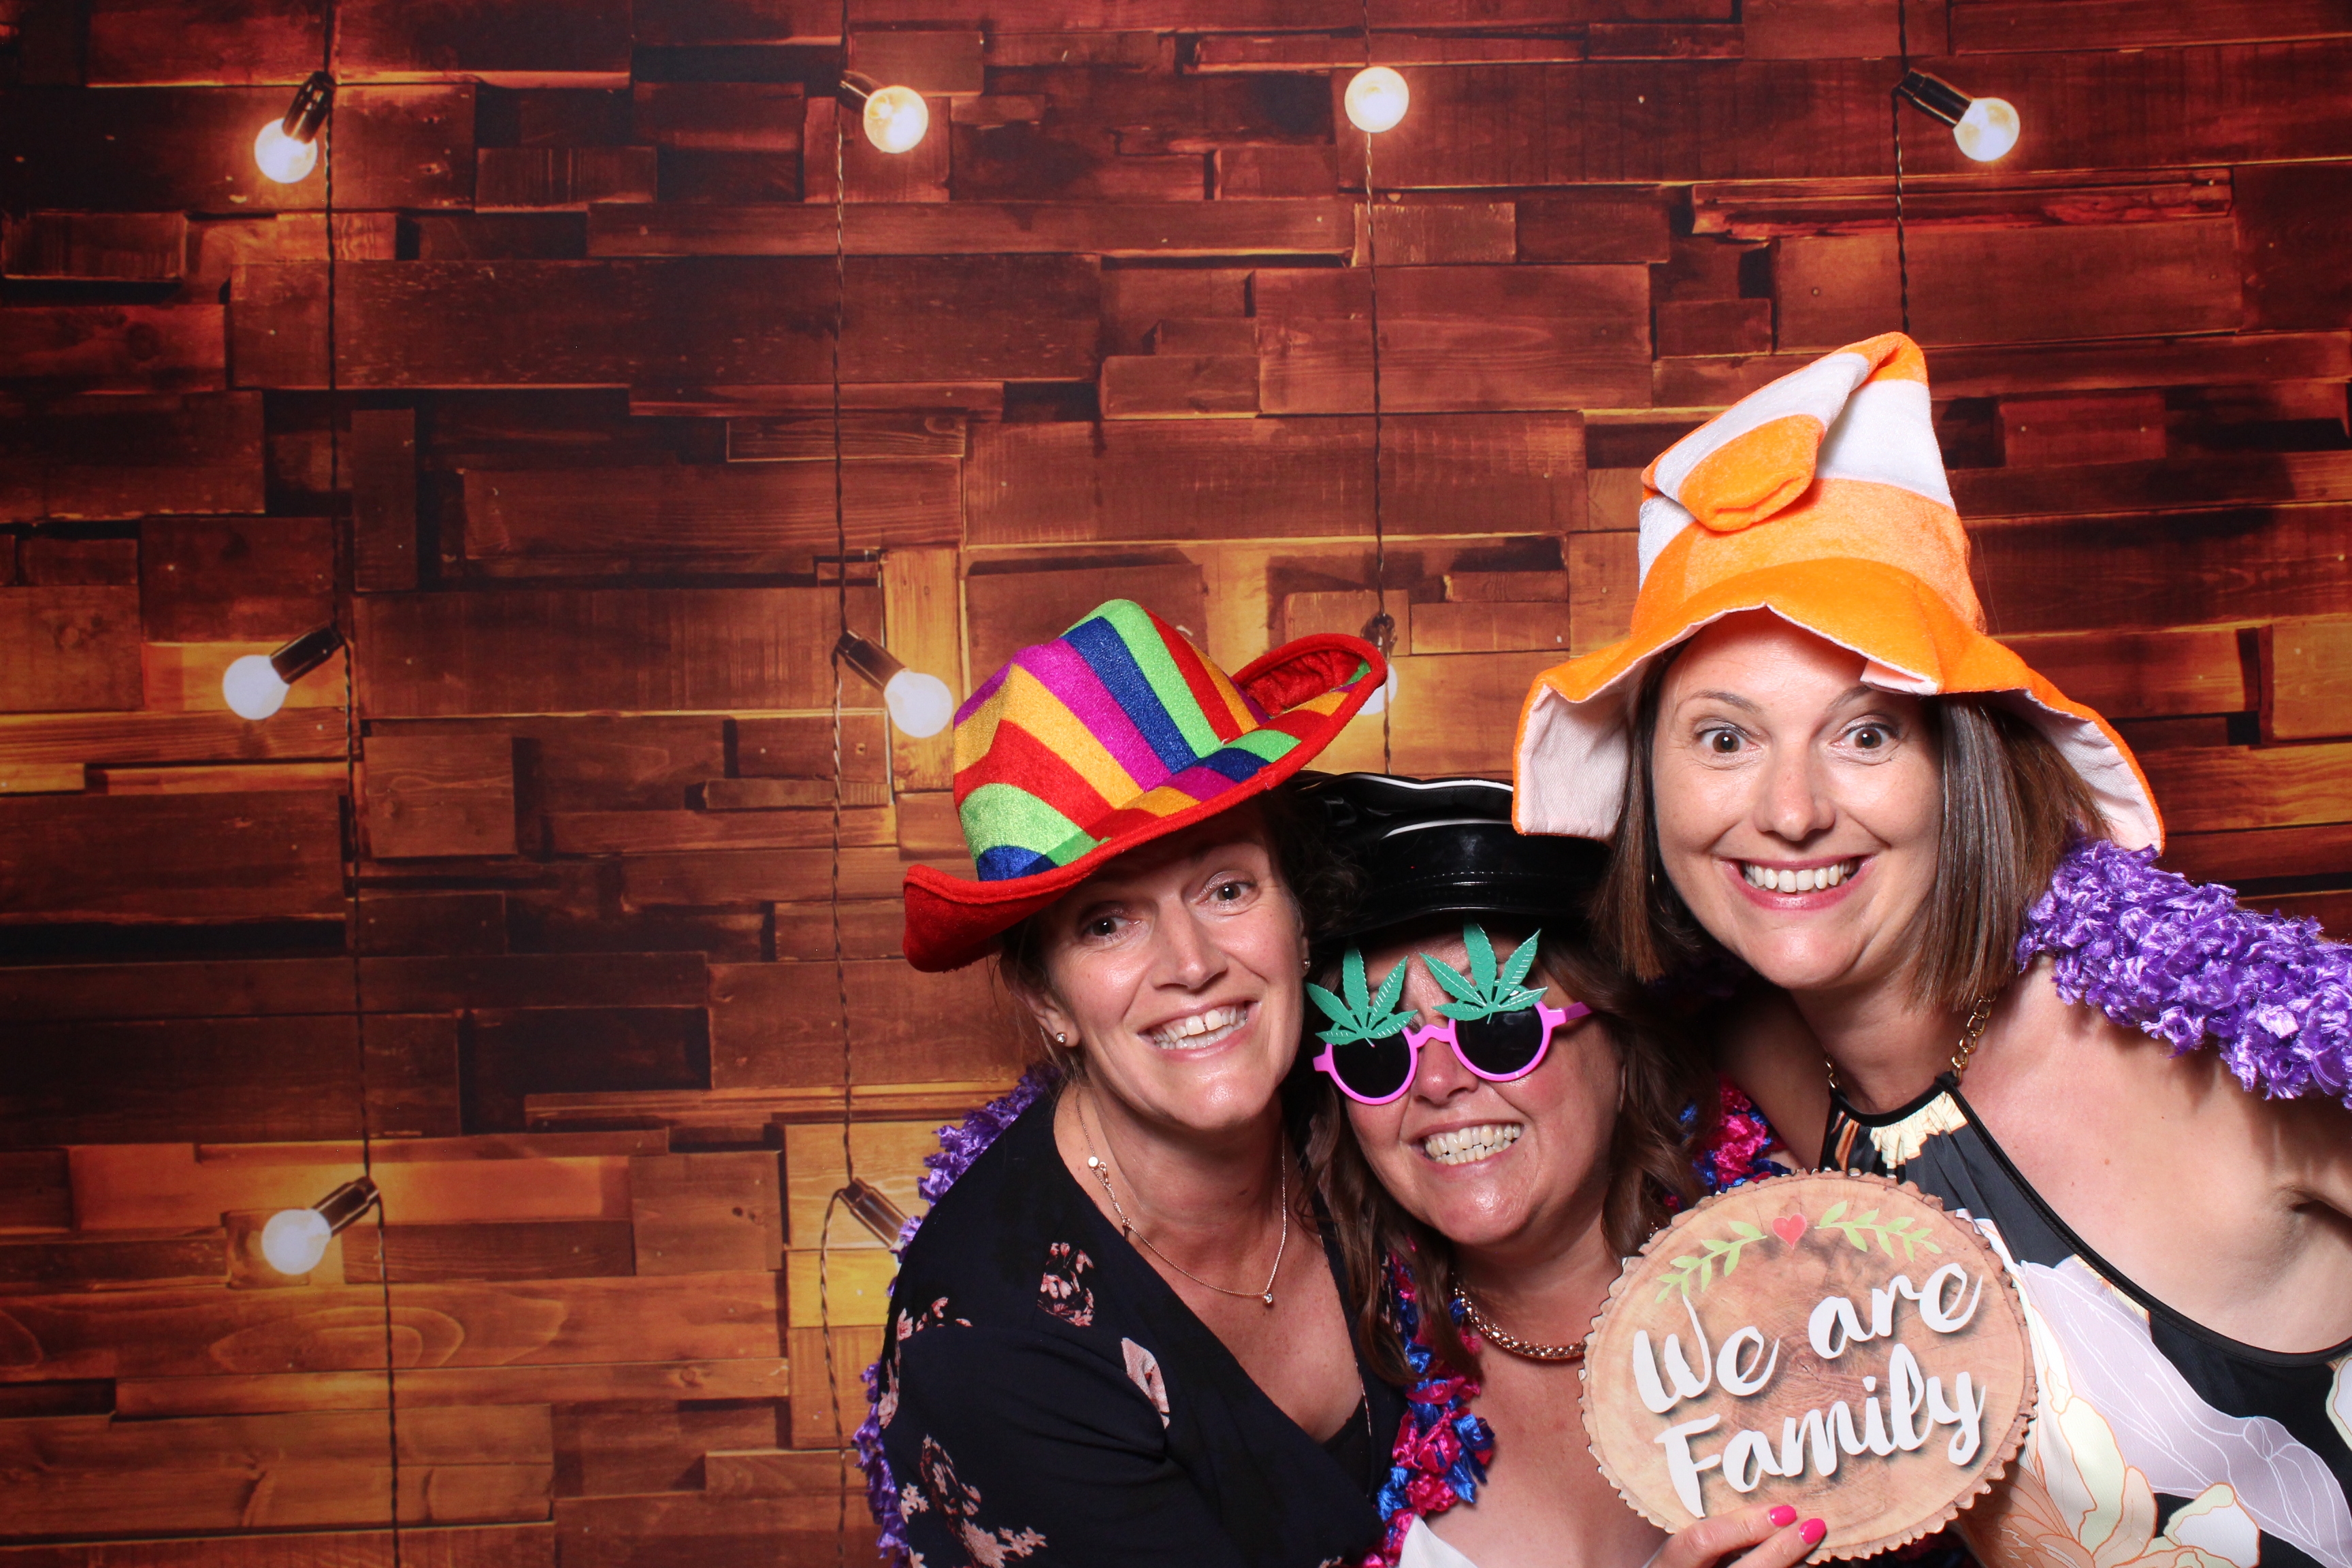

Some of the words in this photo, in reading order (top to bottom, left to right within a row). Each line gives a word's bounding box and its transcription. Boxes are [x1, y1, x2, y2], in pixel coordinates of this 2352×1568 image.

[1633, 1292, 1780, 1414] We
[1808, 1262, 1983, 1360] are
[1654, 1343, 1986, 1518] Family
